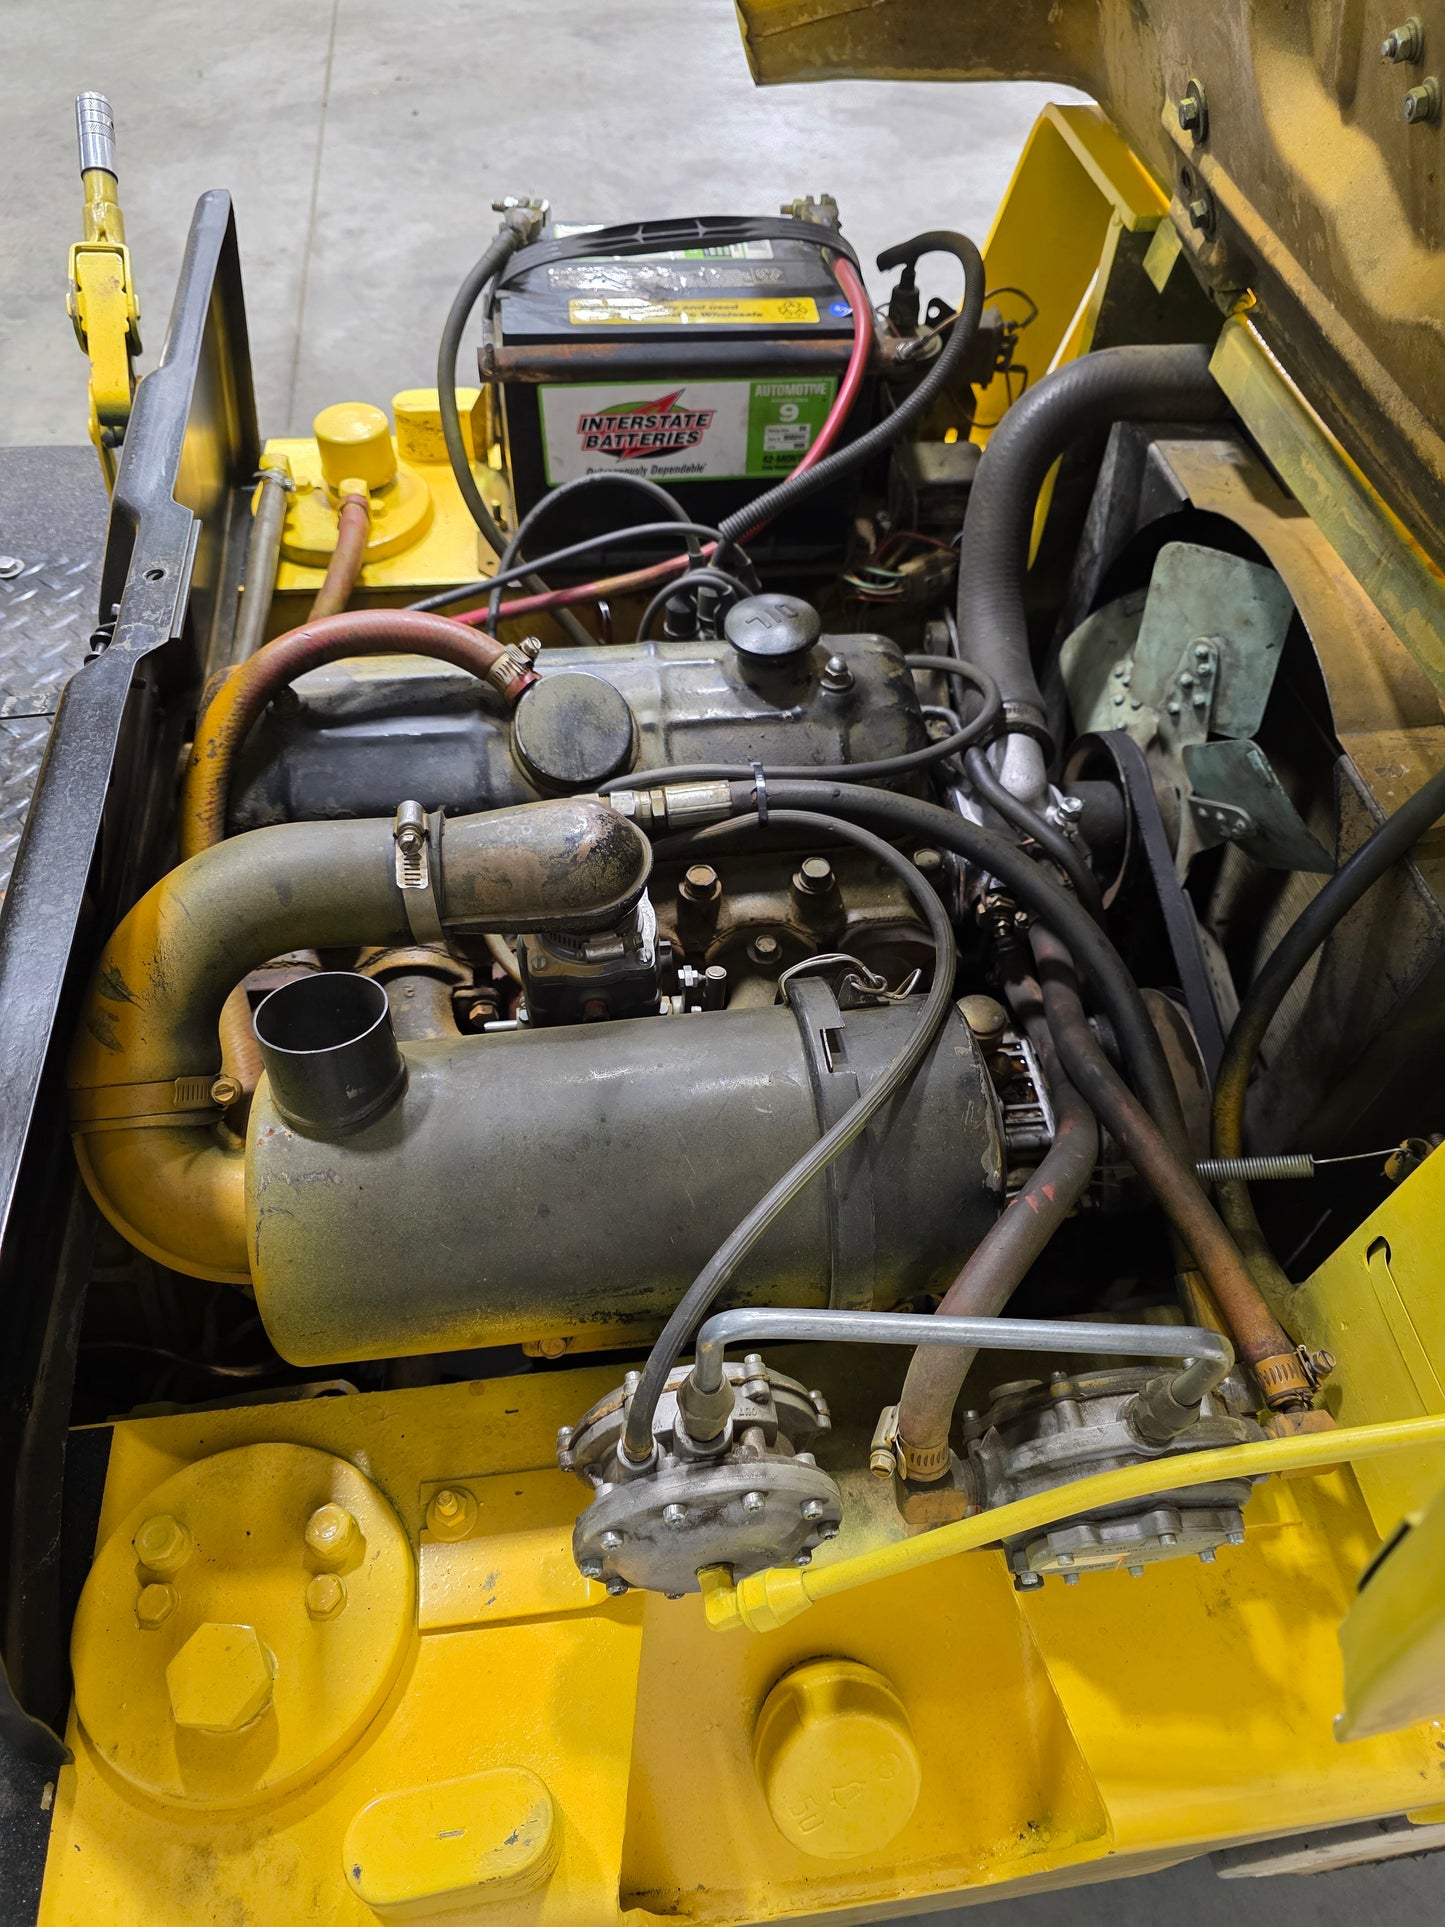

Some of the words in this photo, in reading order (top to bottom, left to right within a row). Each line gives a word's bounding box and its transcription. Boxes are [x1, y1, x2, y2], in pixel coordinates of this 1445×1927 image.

[755, 383, 827, 397] AUTOMOTIVE
[581, 411, 711, 432] INTERSTATE
[779, 403, 800, 423] 9
[585, 431, 701, 449] BATTERIES
[745, 604, 799, 630] OIL
